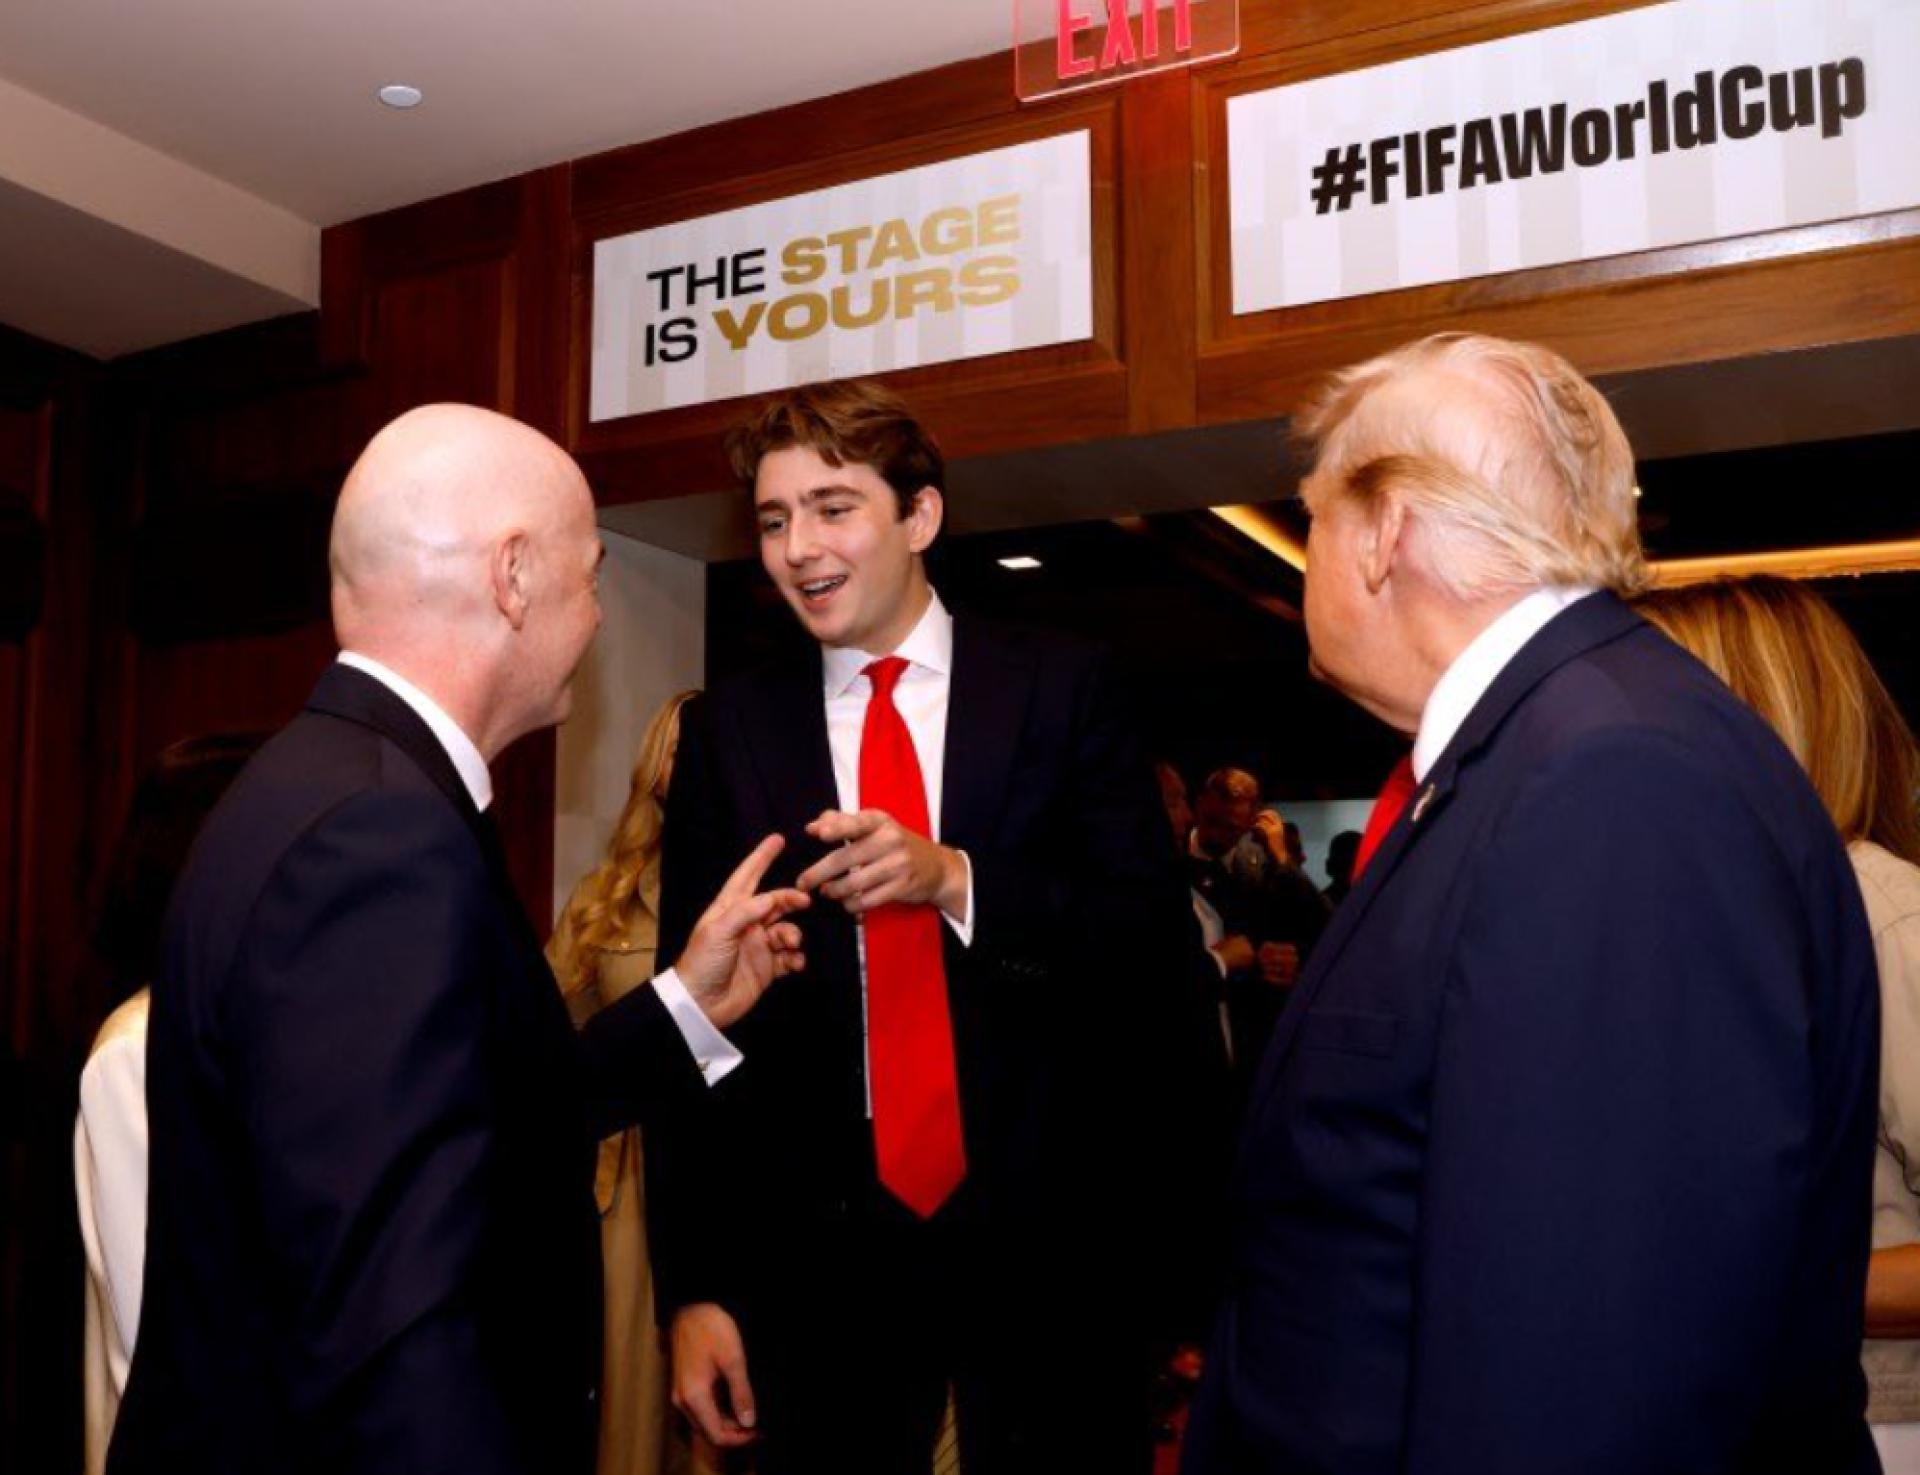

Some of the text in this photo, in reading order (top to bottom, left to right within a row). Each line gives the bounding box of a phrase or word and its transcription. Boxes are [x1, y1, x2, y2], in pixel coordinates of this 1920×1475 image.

[1310, 55, 1867, 215] #FIFAWorldCup
[646, 195, 1021, 311] THE STAGE
[644, 256, 1021, 367] IS YOURS
